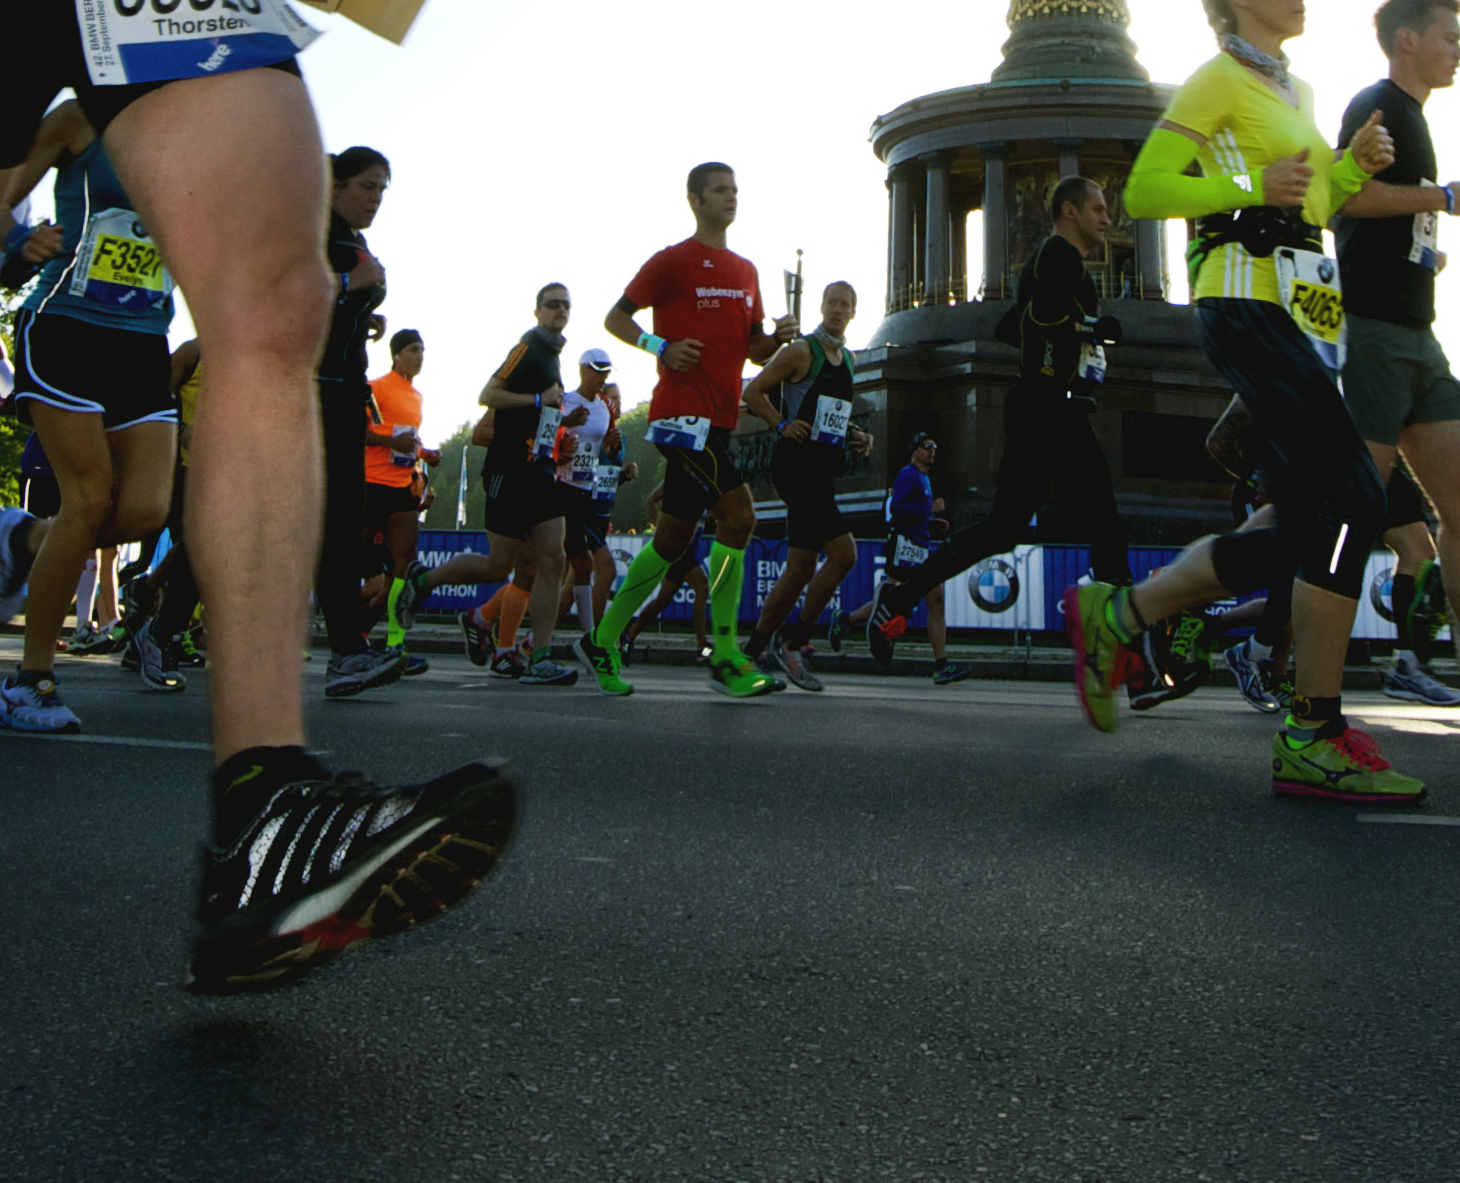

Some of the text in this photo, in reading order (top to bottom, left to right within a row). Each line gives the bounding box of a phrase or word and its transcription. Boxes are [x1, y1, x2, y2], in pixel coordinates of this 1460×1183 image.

[89, 23, 100, 51] BMW
[96, 0, 112, 52] September
[197, 43, 232, 72] here
[697, 298, 720, 310] plus
[431, 584, 477, 598] ATHON
